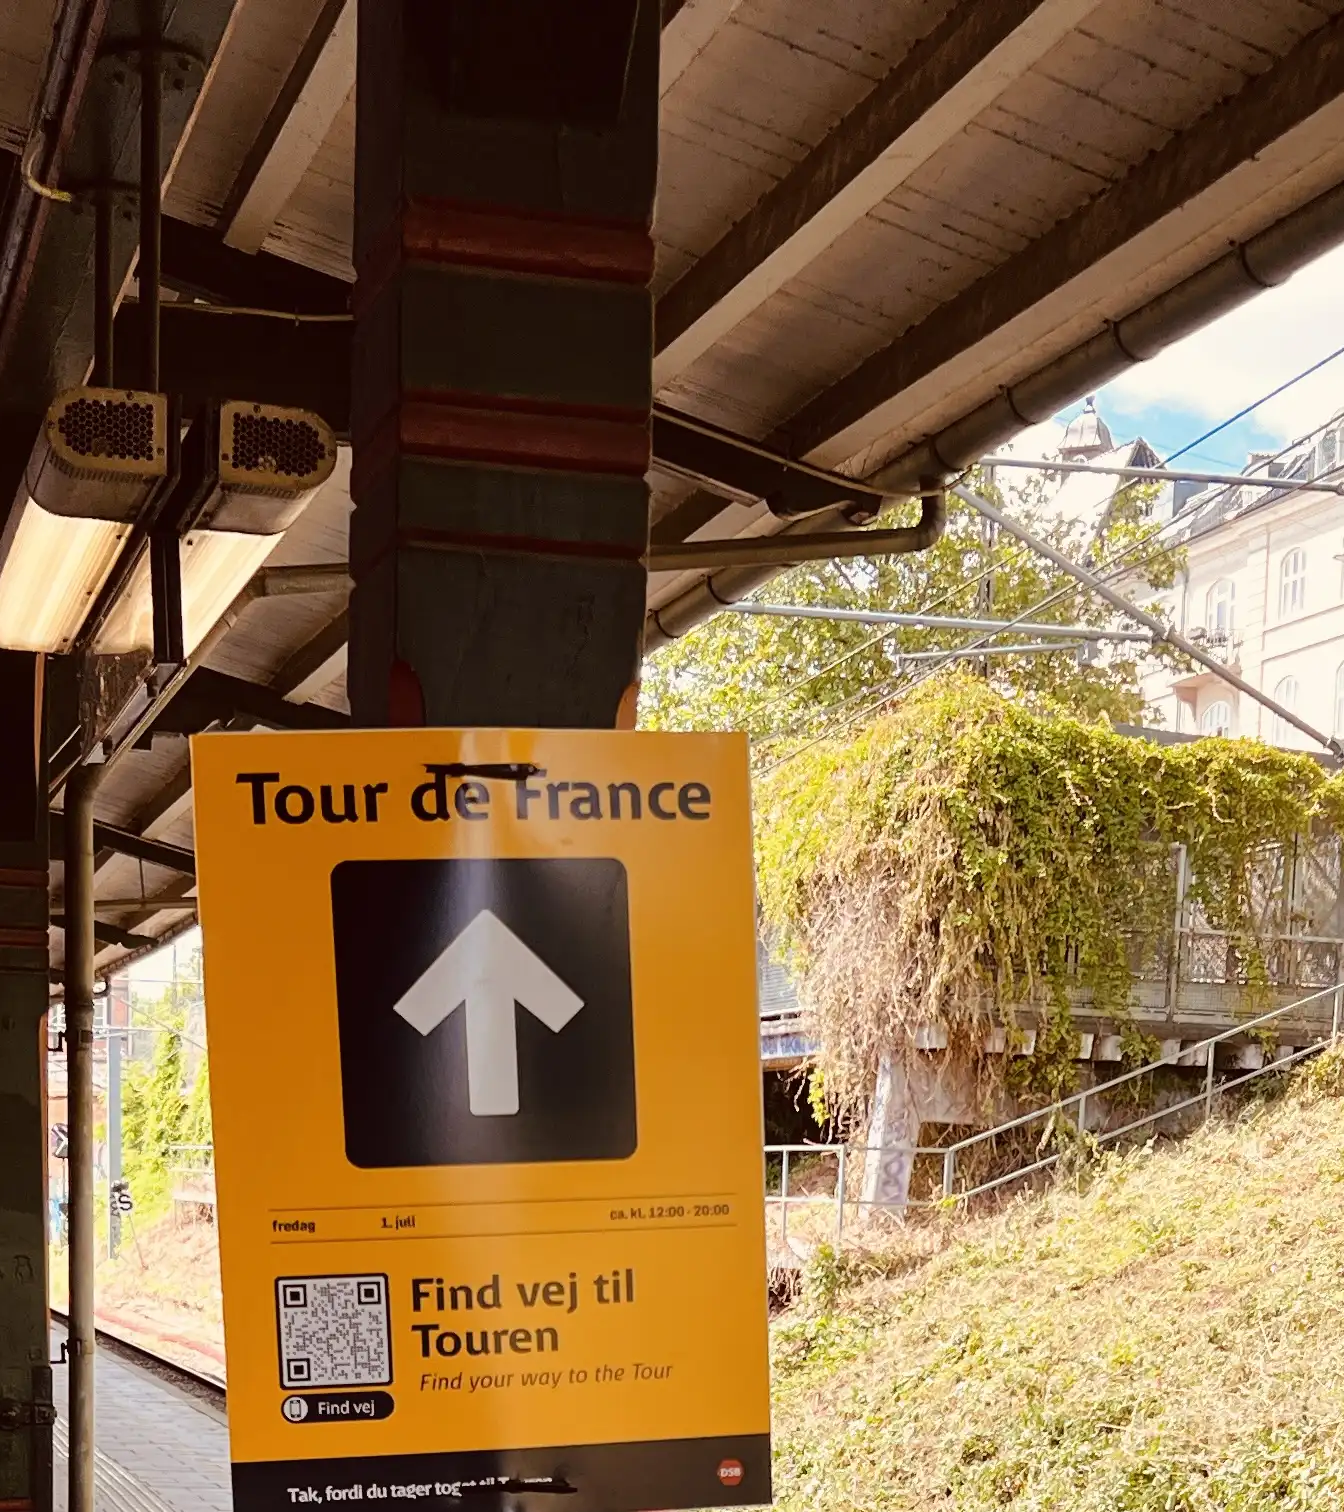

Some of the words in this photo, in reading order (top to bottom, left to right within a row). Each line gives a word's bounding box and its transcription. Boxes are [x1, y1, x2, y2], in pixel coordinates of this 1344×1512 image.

[235, 772, 389, 824] Tour
[410, 764, 490, 823] de
[516, 767, 711, 820] France
[272, 1219, 316, 1233] fredag
[395, 1215, 416, 1230] juli
[609, 1208, 628, 1221] ca.
[648, 1204, 685, 1219] 12:00
[693, 1203, 731, 1217] 20:00
[411, 1273, 503, 1312] Find
[516, 1272, 579, 1314] vej
[593, 1268, 635, 1304] til
[410, 1323, 559, 1358] Touren
[419, 1371, 463, 1392] Find
[469, 1374, 514, 1393] your
[521, 1370, 563, 1389] way
[570, 1368, 588, 1384] to
[594, 1364, 625, 1383] the
[631, 1362, 674, 1380] Tour
[317, 1400, 350, 1415] Find
[353, 1400, 375, 1417] vej
[287, 1486, 323, 1504] Tak,
[325, 1484, 364, 1501] fordi
[367, 1483, 388, 1499] du
[390, 1482, 432, 1499] tager
